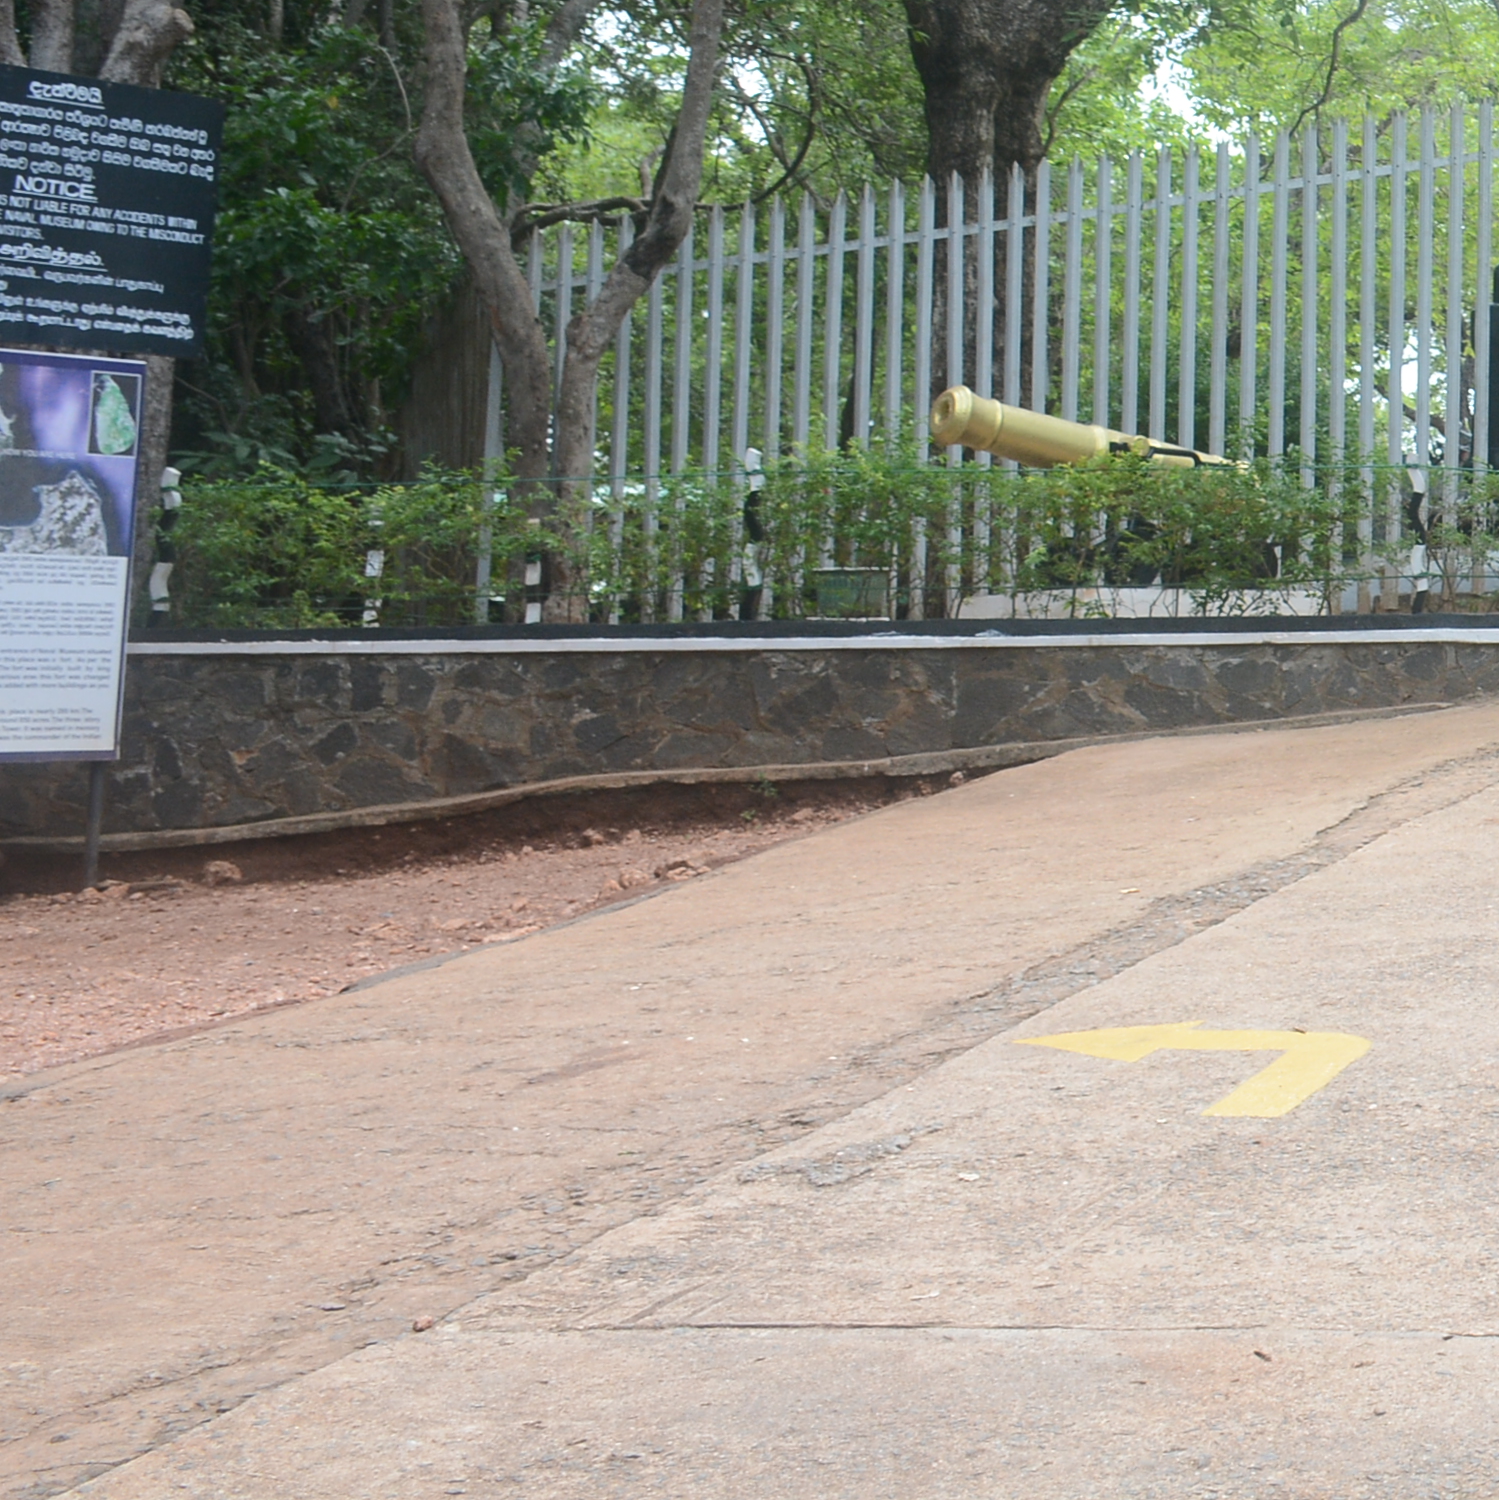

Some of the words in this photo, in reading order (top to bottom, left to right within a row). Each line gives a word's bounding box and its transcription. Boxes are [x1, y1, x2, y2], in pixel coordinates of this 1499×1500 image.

[5, 209, 38, 225] NAVAL
[40, 214, 86, 230] MUSEUM
[116, 223, 129, 236] TO
[130, 225, 148, 238] THE
[148, 228, 205, 245] MISCONDUCT
[9, 195, 32, 209] NOT
[33, 199, 68, 214] LIABLE
[70, 203, 91, 216] FOR
[91, 206, 114, 219] ANY
[113, 209, 166, 226] ACCIDENTS
[167, 216, 198, 230] WITHIN
